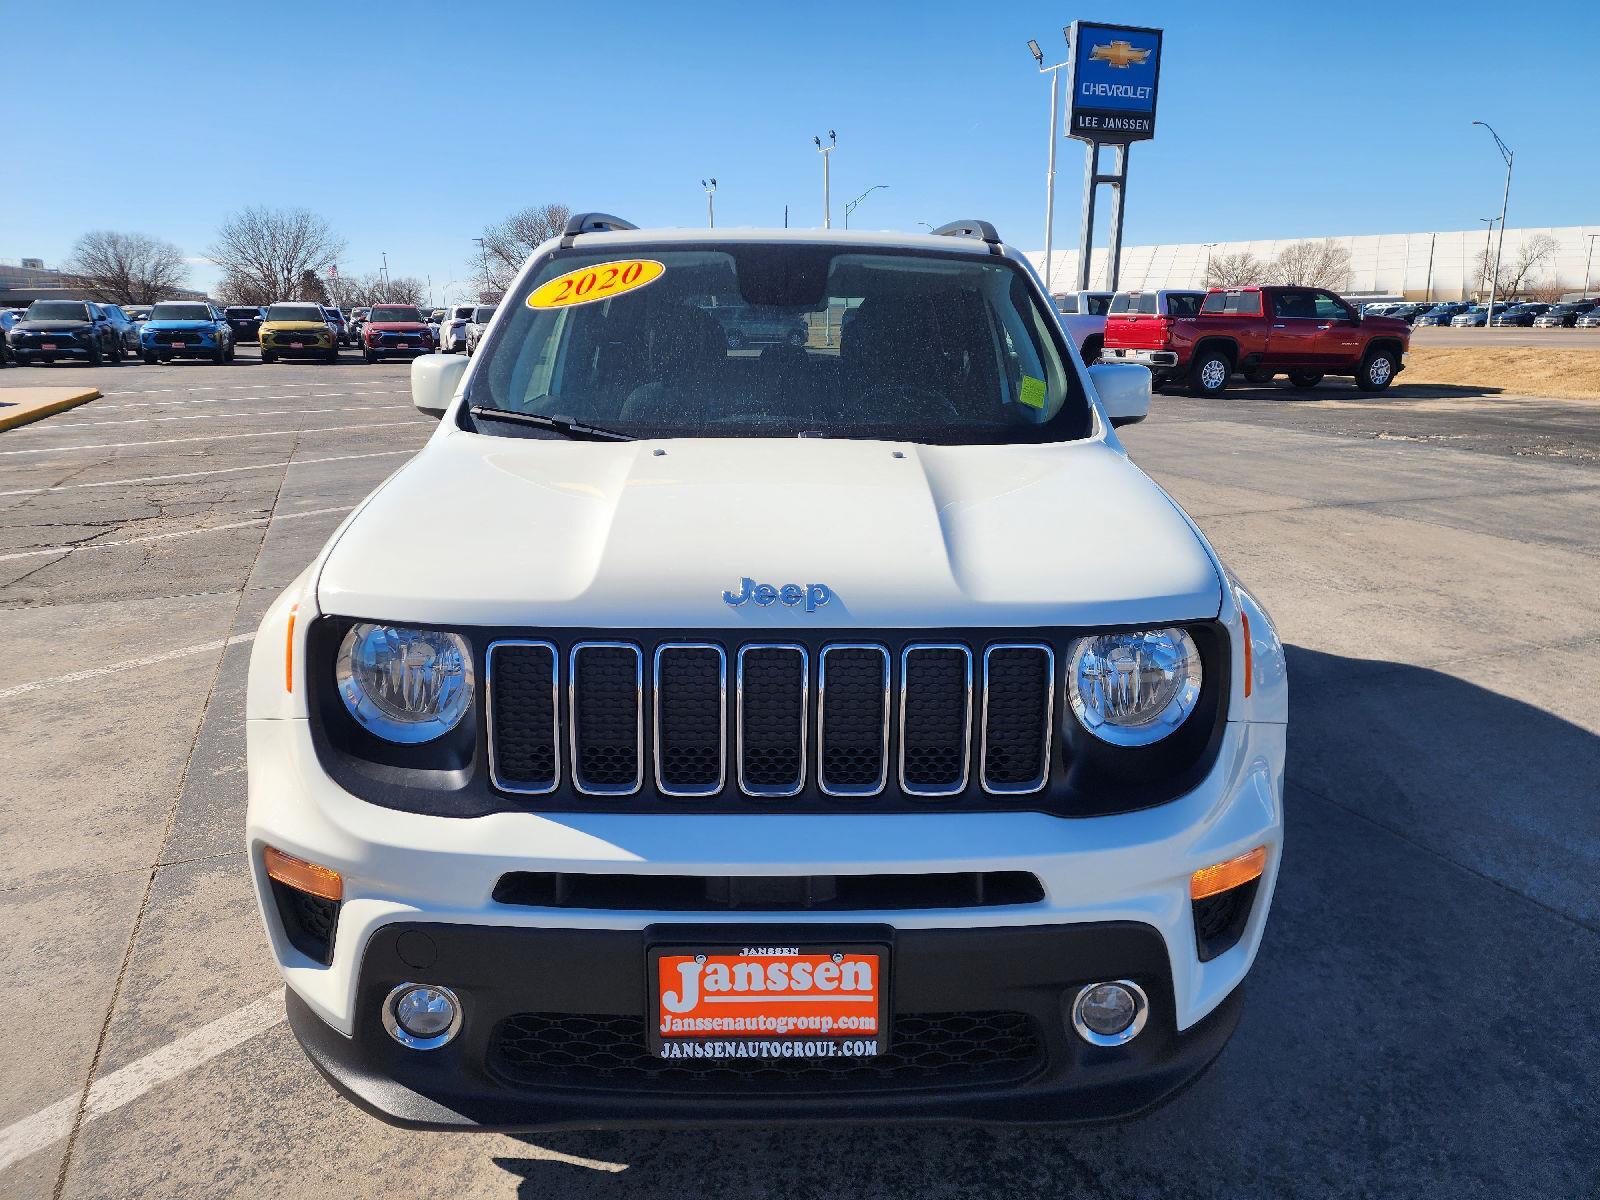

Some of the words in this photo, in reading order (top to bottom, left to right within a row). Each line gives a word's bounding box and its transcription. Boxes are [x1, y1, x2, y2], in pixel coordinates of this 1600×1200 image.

[1082, 82, 1152, 99] CHEVROLET
[1079, 115, 1099, 127] LEE
[1102, 117, 1150, 130] JANSSEN
[551, 262, 643, 303] 2020
[721, 576, 832, 613] Jeep
[738, 947, 800, 957] JANSSEN
[661, 960, 873, 1014] Janssen
[660, 1014, 876, 1033] Janssenautogroup.com
